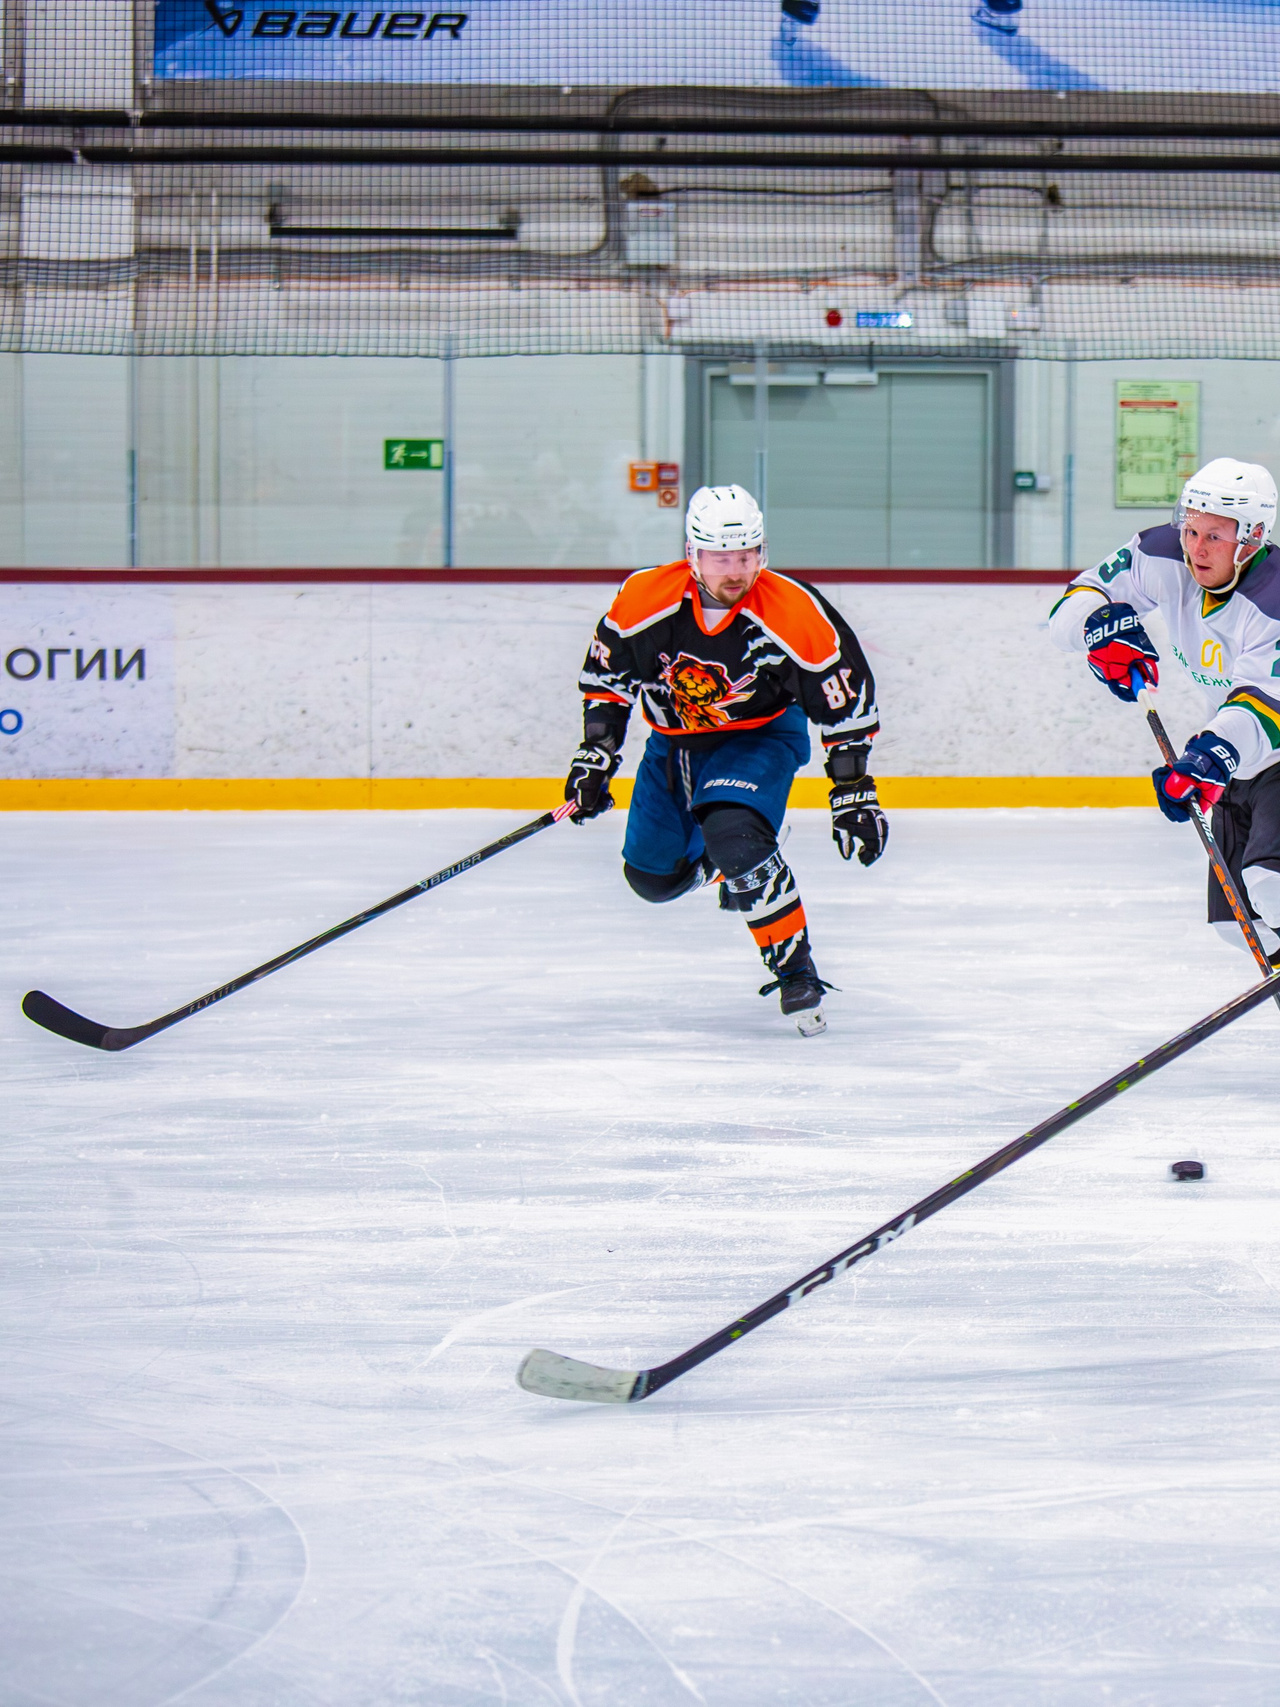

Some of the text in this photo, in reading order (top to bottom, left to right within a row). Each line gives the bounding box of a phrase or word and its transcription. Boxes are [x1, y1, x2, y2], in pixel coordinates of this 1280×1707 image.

[251, 11, 468, 39] BAUER
[703, 779, 758, 792] BAUER
[430, 853, 482, 886] BAUER
